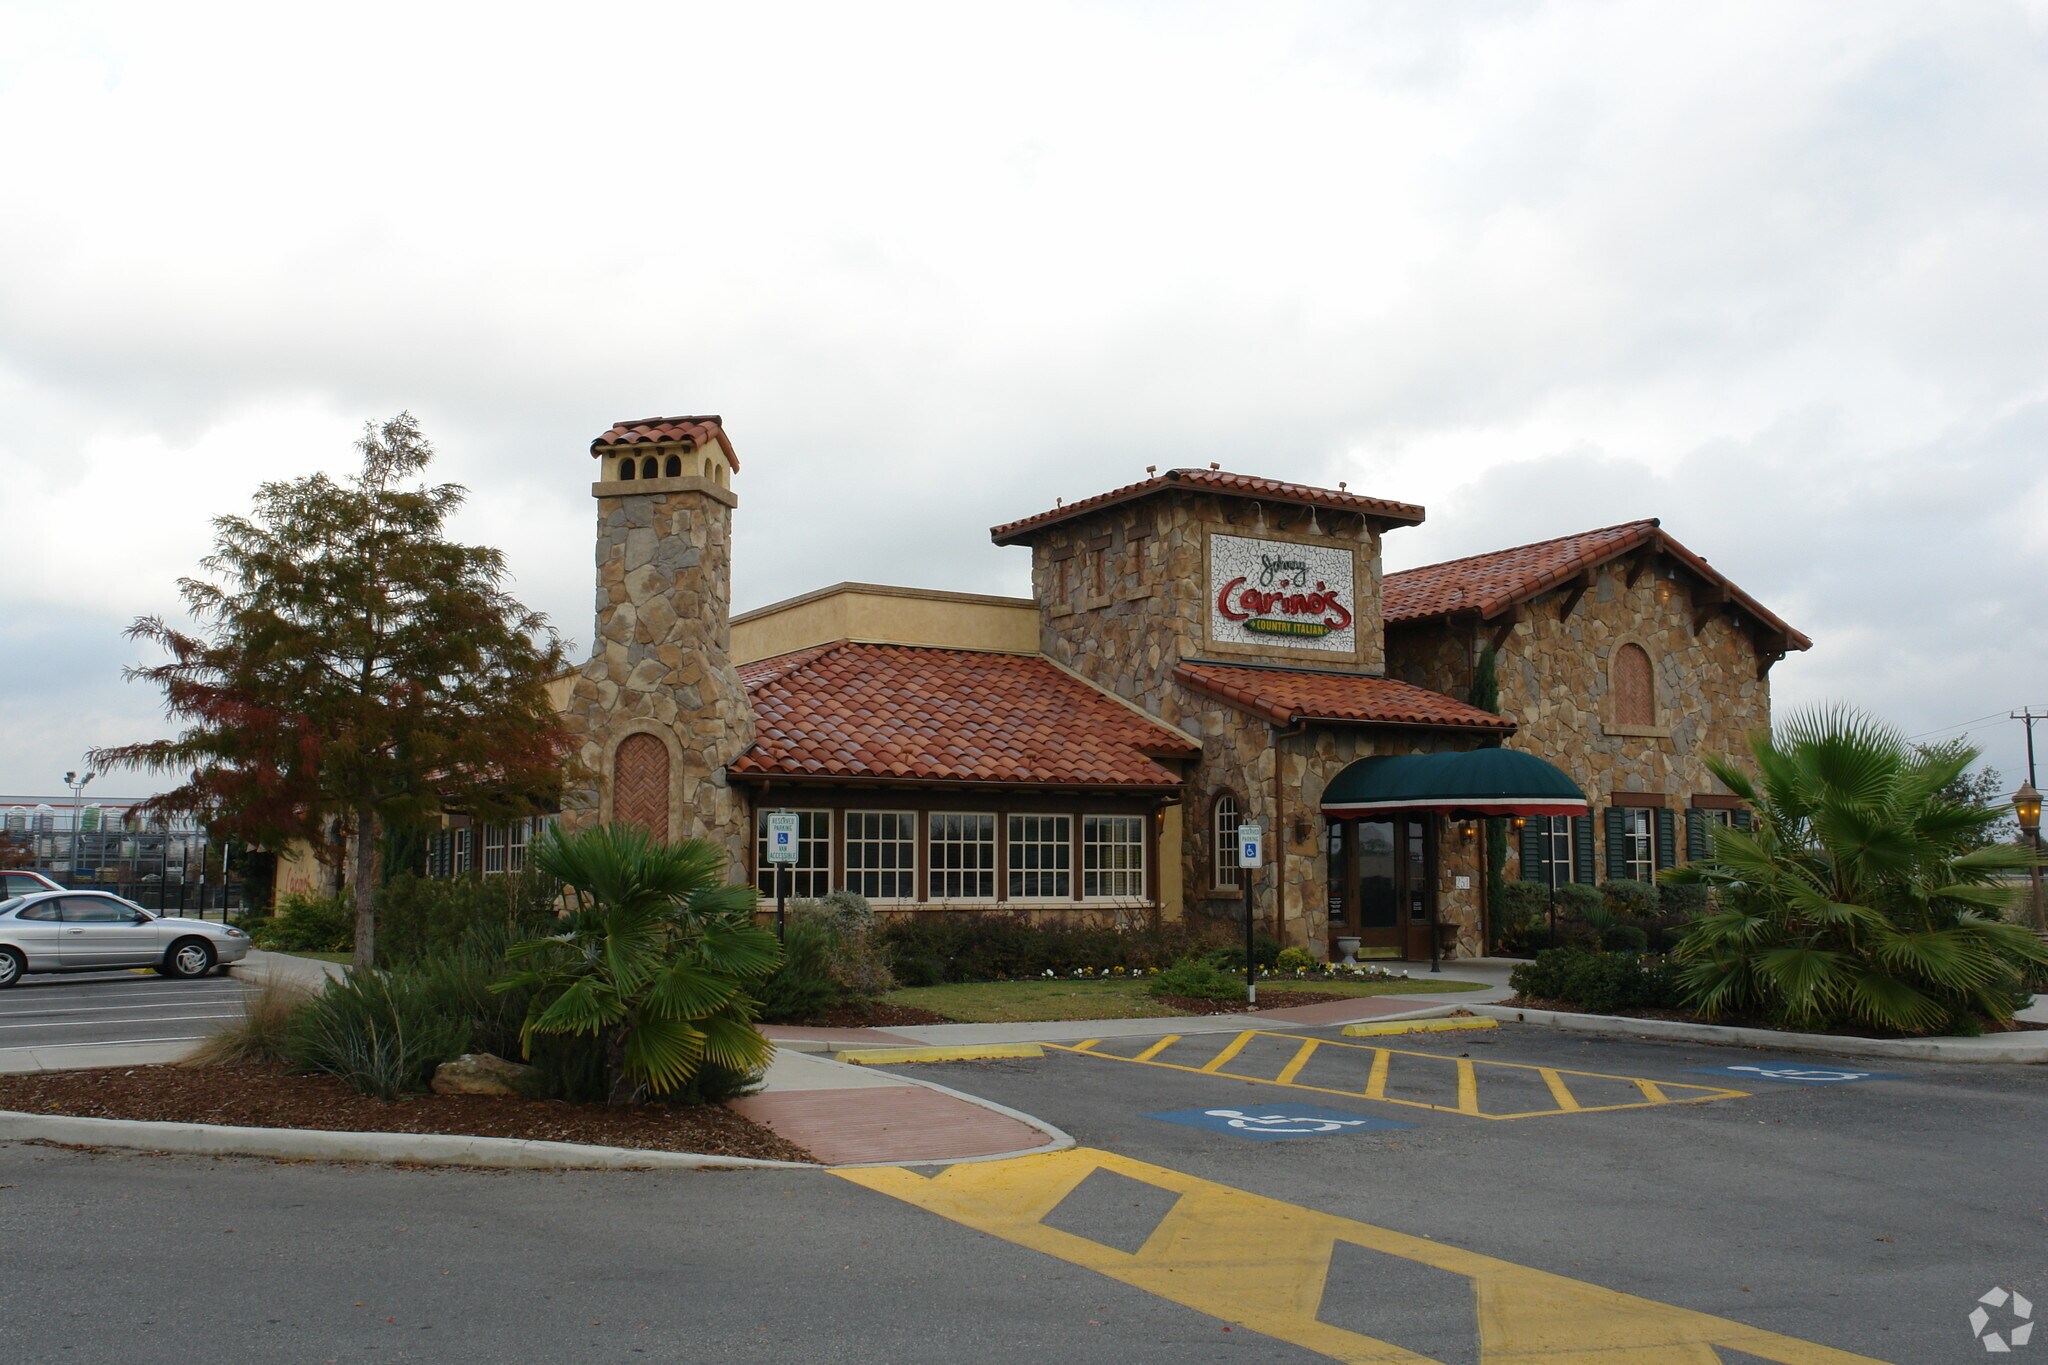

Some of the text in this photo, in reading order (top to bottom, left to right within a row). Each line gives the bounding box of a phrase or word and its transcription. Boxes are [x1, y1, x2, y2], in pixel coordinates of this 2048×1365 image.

[1218, 577, 1351, 630] Carino's
[1257, 620, 1324, 635] COUNTRY ITALIAN
